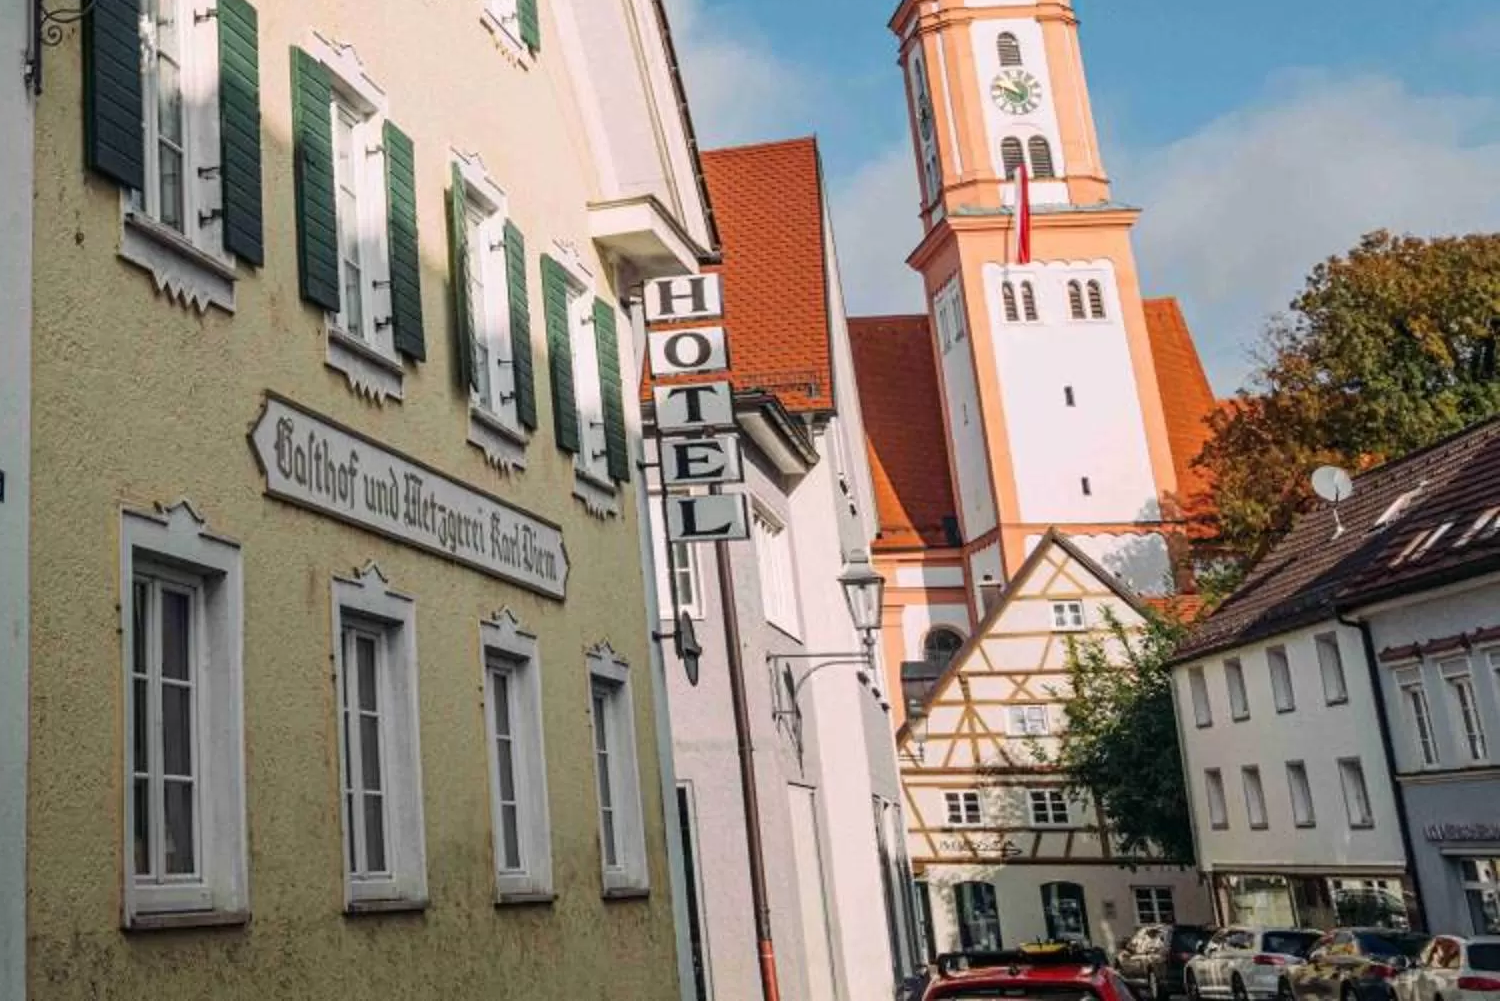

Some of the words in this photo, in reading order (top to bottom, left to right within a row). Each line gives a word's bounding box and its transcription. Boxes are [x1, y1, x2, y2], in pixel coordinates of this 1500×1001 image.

[656, 276, 733, 538] HOTEL
[363, 466, 399, 521] und
[403, 471, 486, 553] Metzgerei
[490, 510, 522, 569] Karl
[522, 524, 557, 581] Diem
